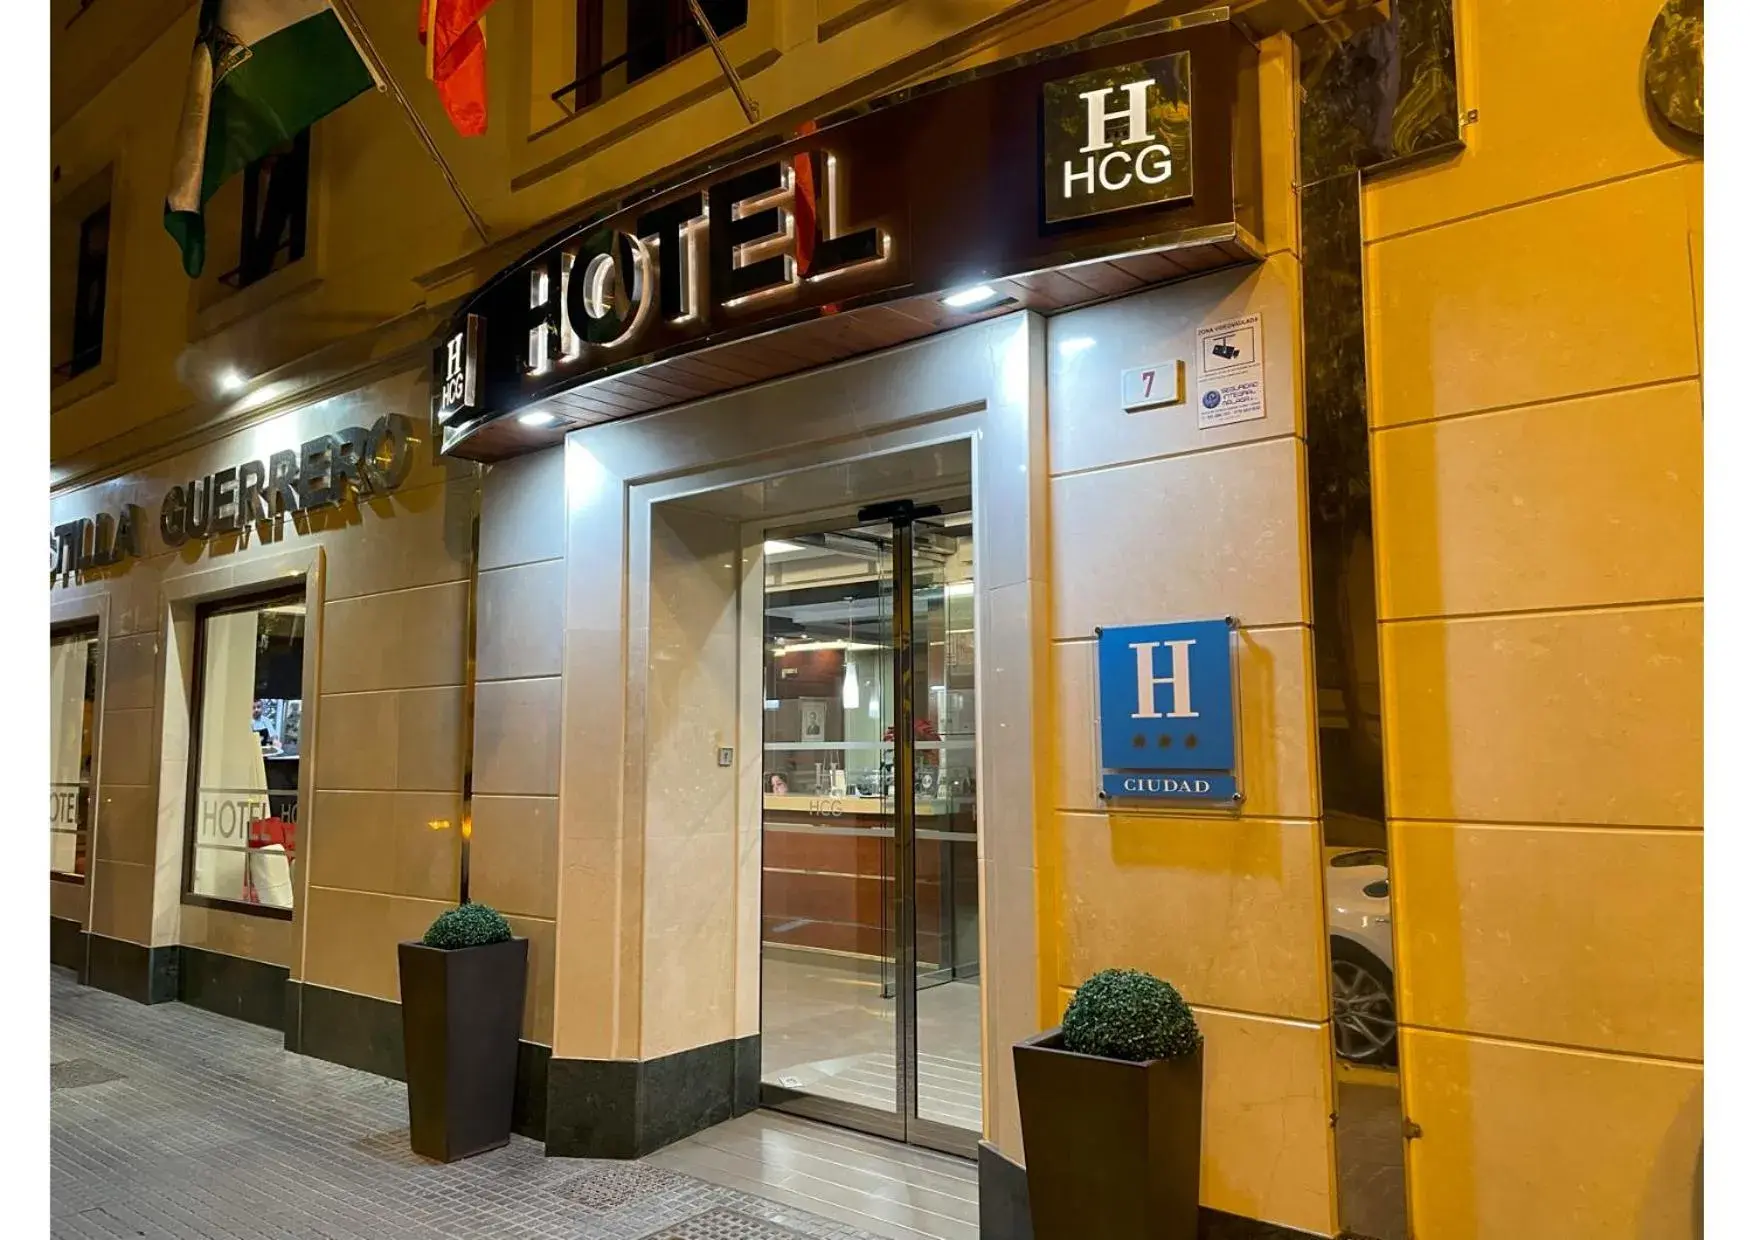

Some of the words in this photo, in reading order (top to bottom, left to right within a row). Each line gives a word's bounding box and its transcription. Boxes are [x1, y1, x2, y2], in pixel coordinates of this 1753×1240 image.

[1079, 78, 1156, 153] H
[1064, 144, 1172, 198] HCG
[518, 149, 887, 375] HOTEL
[446, 332, 463, 381] H
[443, 373, 464, 409] HCG
[1141, 371, 1155, 398] 7
[160, 413, 413, 546] GUERRERO
[1128, 639, 1199, 718] H
[809, 800, 843, 817] HCG
[1124, 778, 1210, 793] CIUDAD
